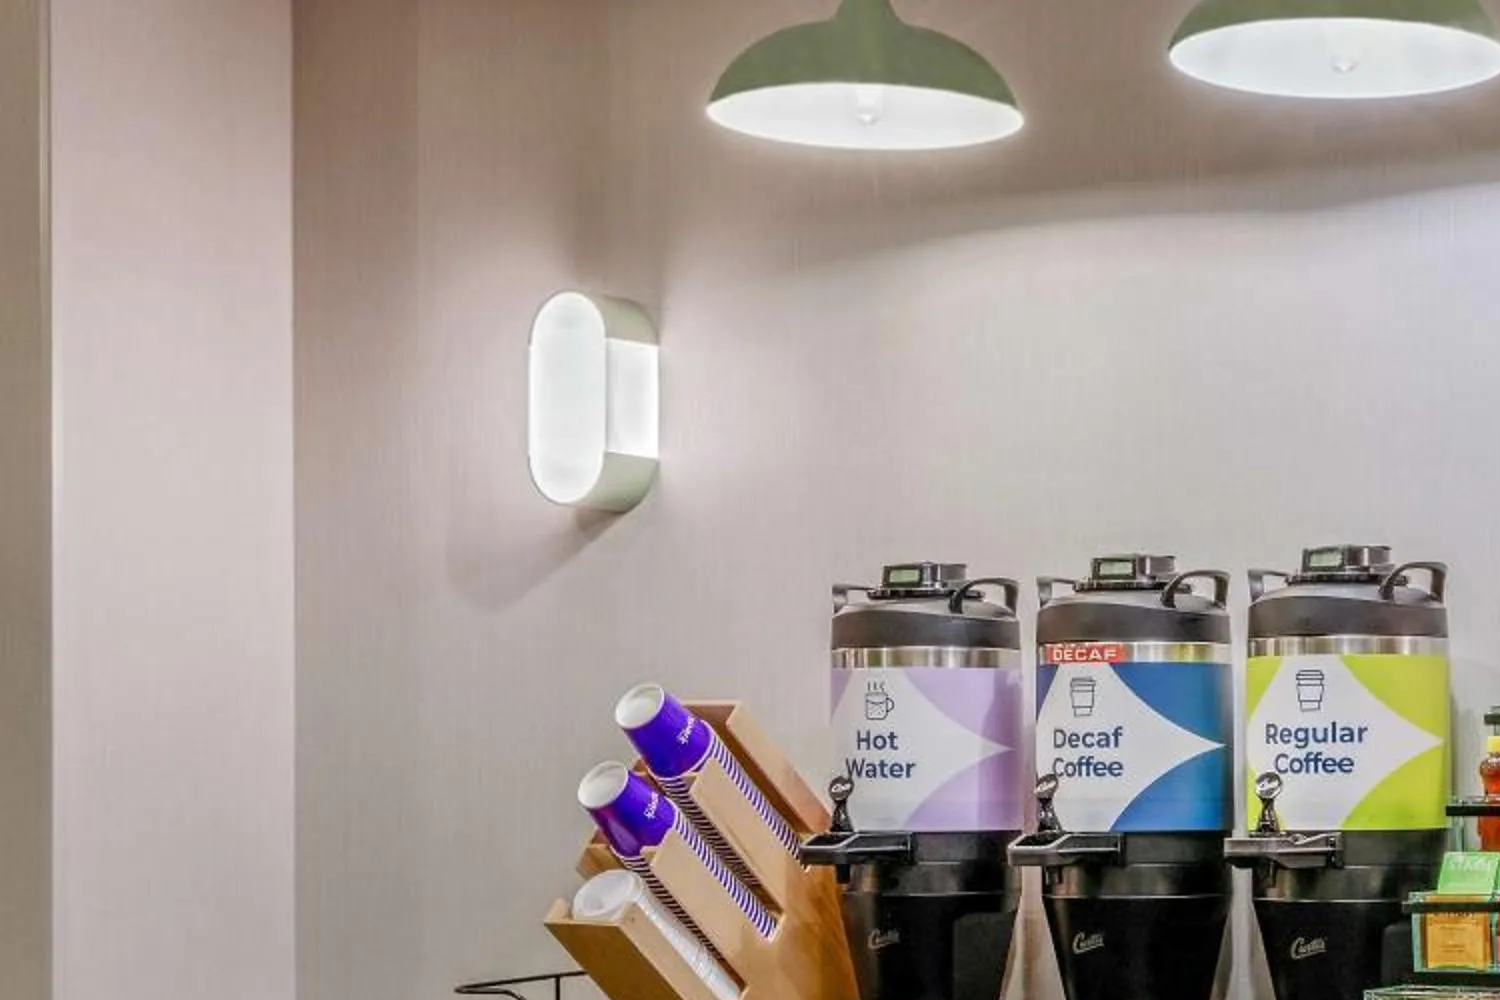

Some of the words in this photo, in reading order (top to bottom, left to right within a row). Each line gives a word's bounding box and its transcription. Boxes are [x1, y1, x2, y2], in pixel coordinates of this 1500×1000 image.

[1053, 647, 1117, 661] DECAF
[857, 729, 899, 751] Hot
[1053, 725, 1124, 749] Decaf
[1265, 721, 1369, 749] Regular
[845, 757, 917, 779] Water
[1052, 755, 1125, 777] Coffee
[1274, 751, 1355, 774] Coffee
